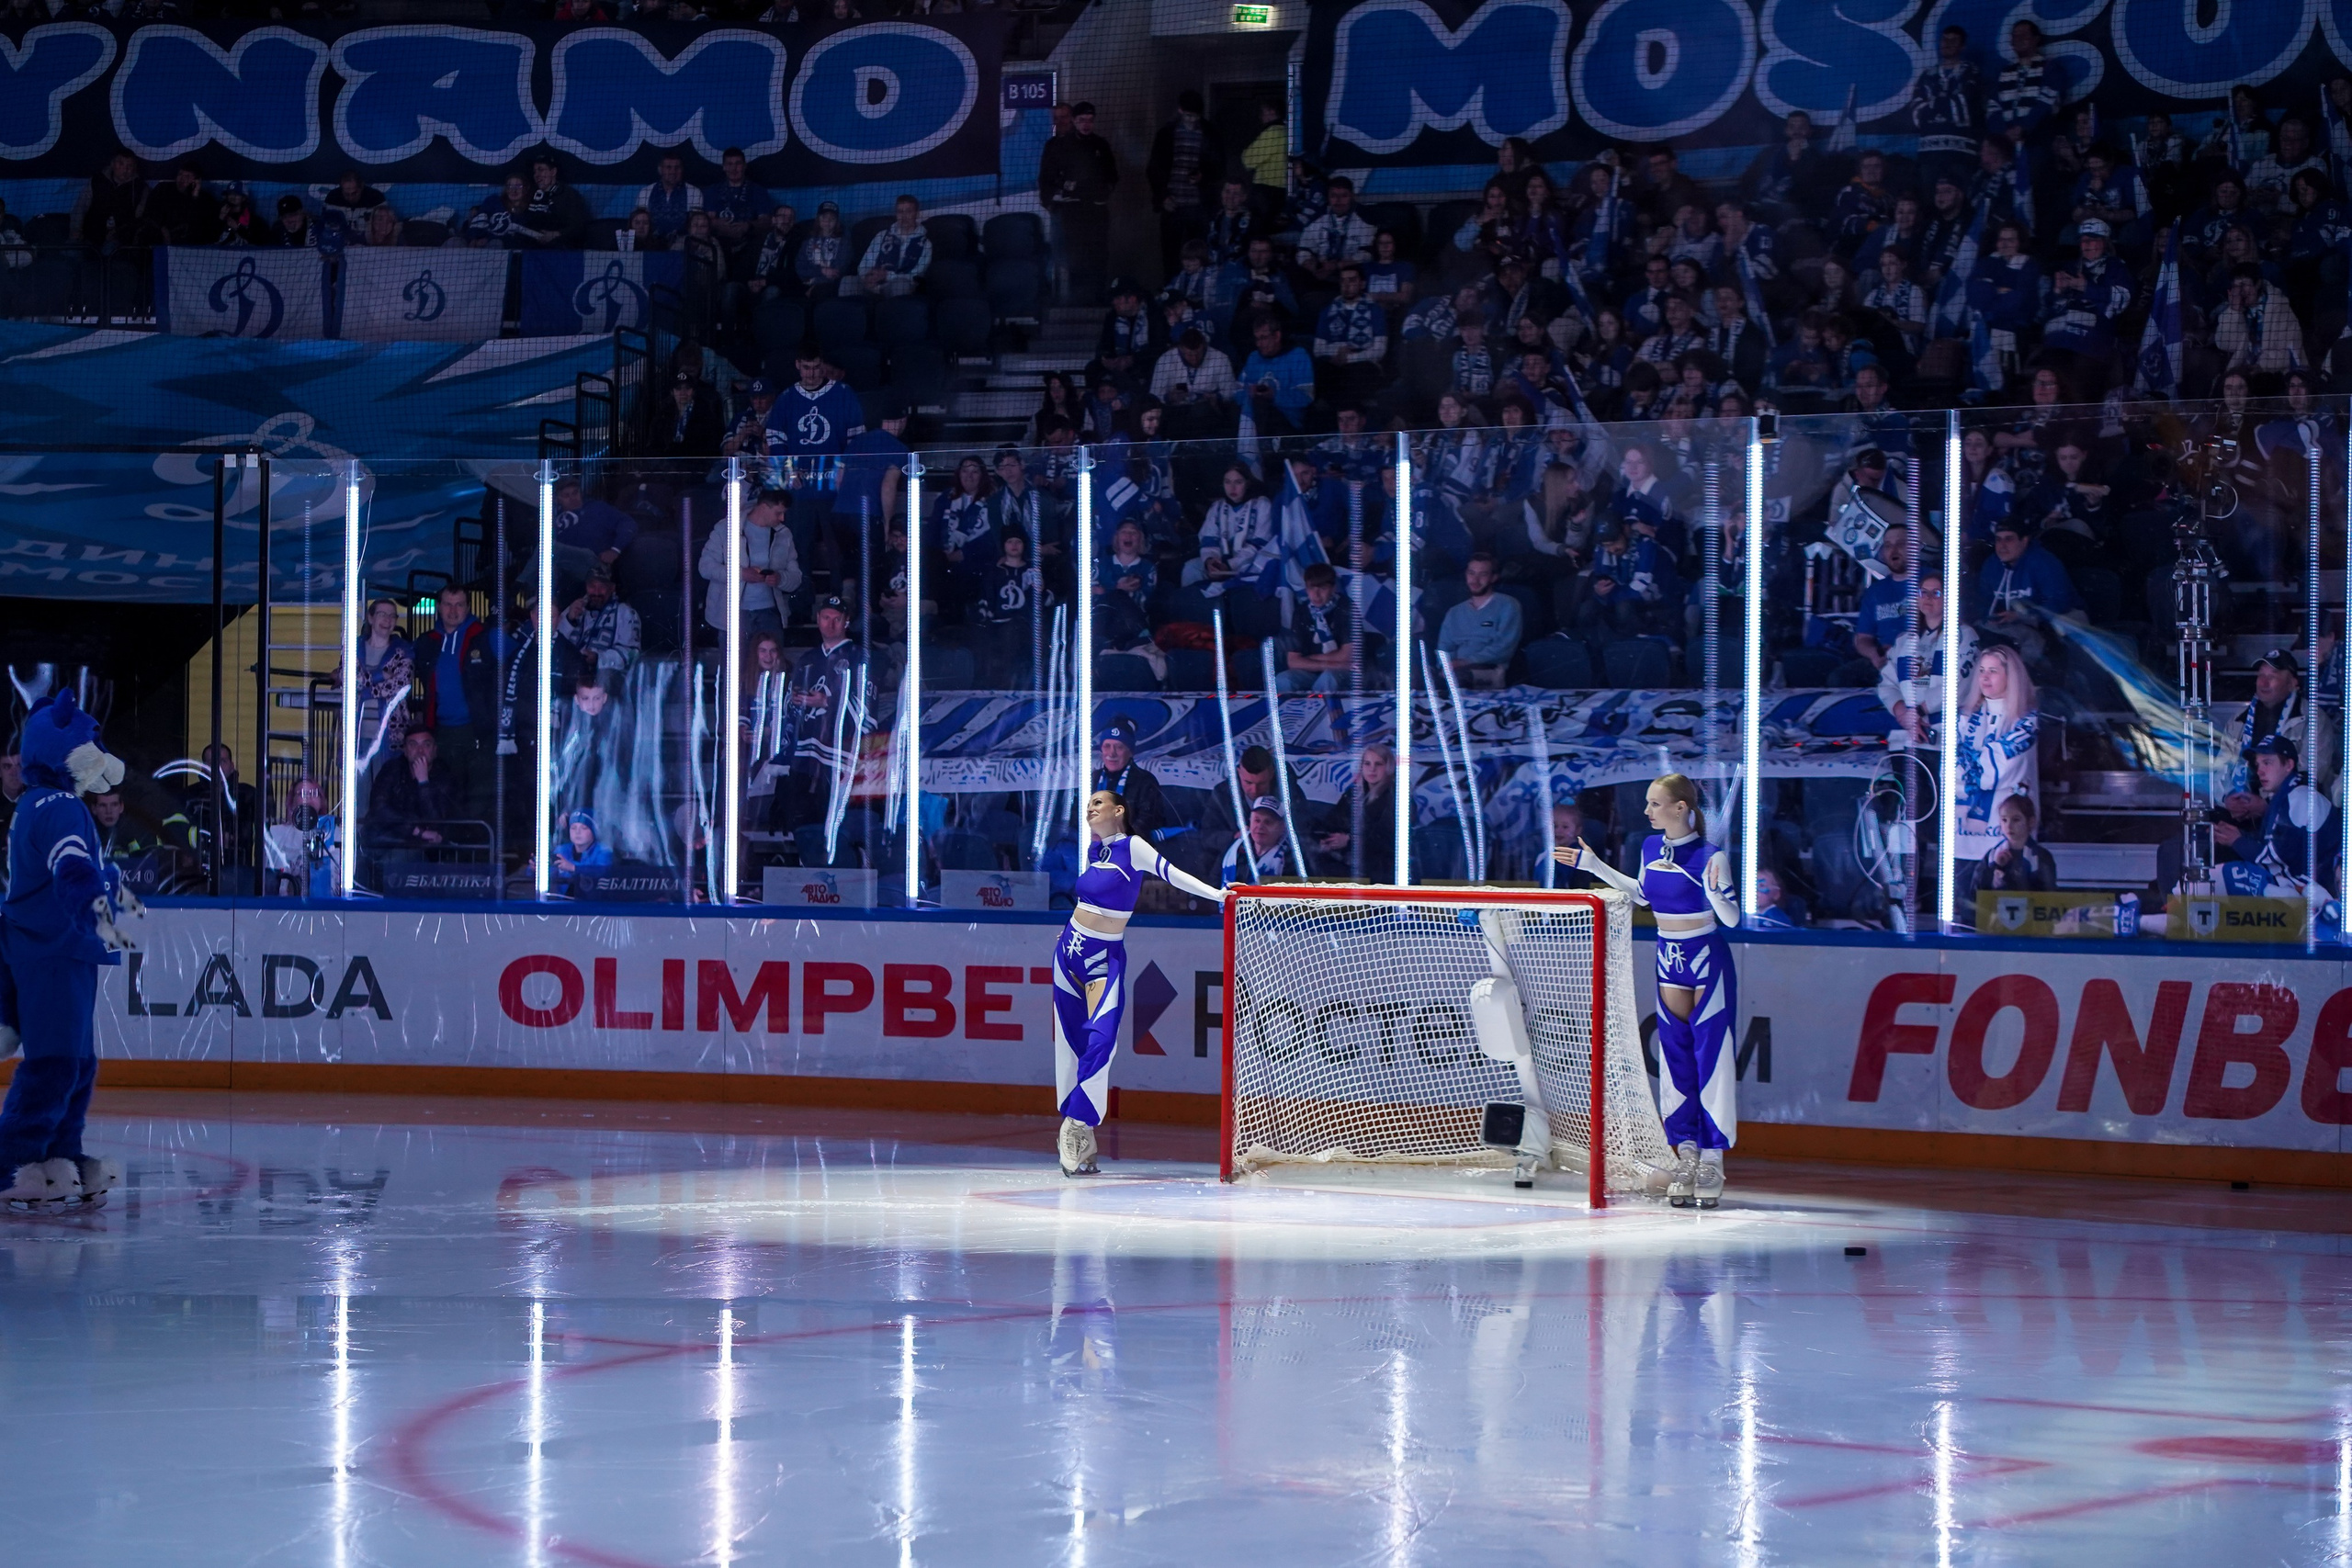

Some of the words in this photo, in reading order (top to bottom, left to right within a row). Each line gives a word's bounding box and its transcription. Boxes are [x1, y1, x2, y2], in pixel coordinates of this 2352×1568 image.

[1008, 84, 1020, 99] B
[1020, 83, 1047, 99] 105
[419, 874, 492, 888] БАЛТИКА
[609, 877, 680, 891] БАЛТИКА
[800, 884, 828, 894] АВТО
[976, 887, 1001, 897] АВТО
[808, 893, 841, 905] РАДИО
[983, 897, 1013, 908] РАДИО
[2033, 907, 2092, 923] БАНК
[2226, 910, 2288, 928] БАНК
[128, 952, 393, 1021] LADA
